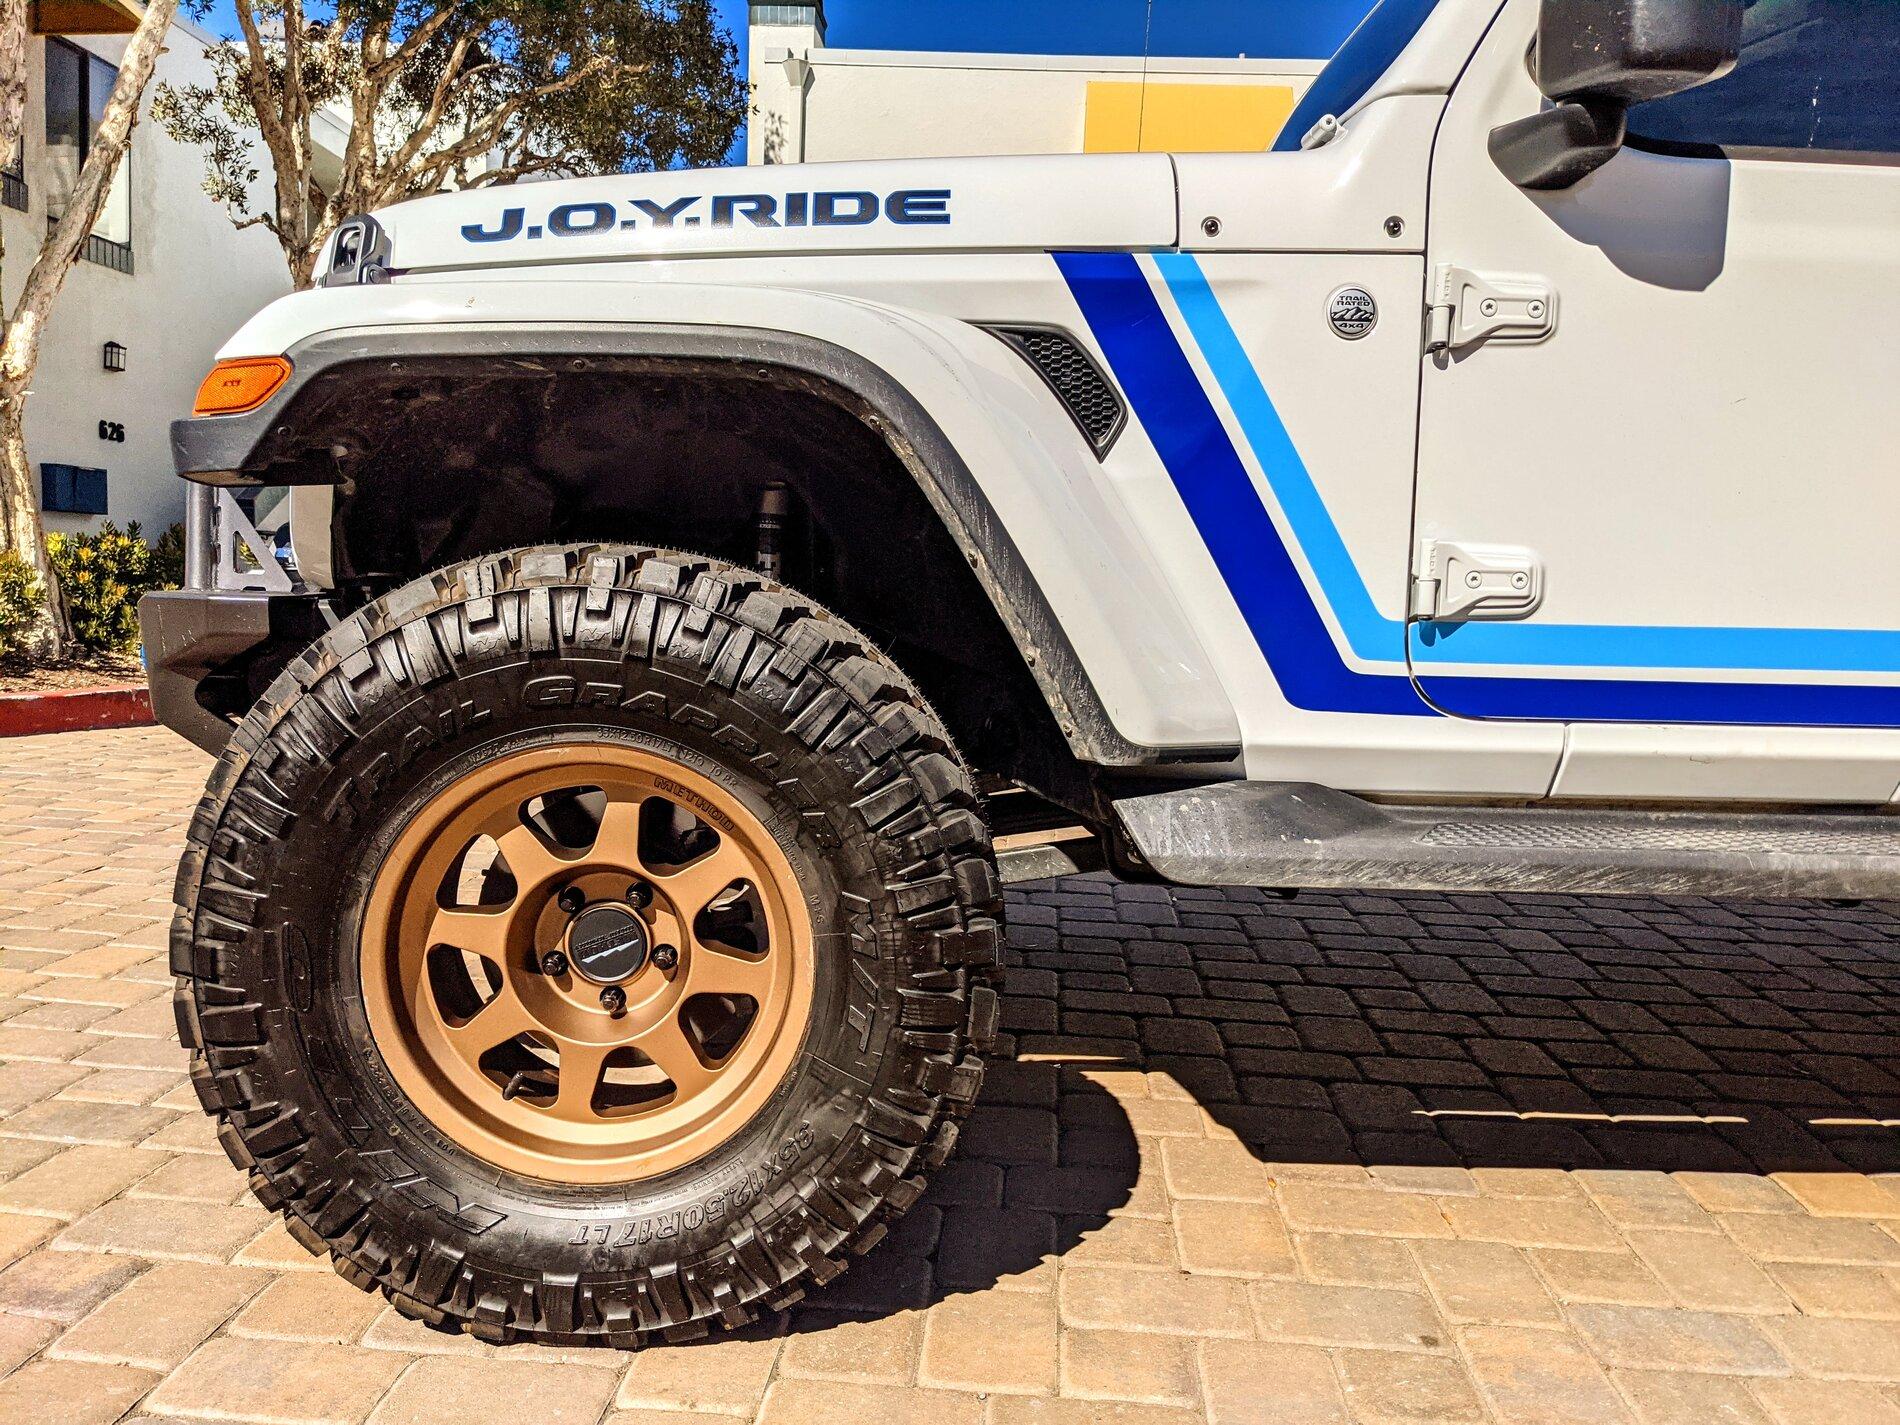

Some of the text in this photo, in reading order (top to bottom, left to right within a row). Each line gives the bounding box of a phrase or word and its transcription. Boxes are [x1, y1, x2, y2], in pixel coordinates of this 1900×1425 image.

[460, 188, 952, 243] J.O.Y.RIDE
[98, 419, 125, 443] 626
[653, 776, 735, 833] METHOD
